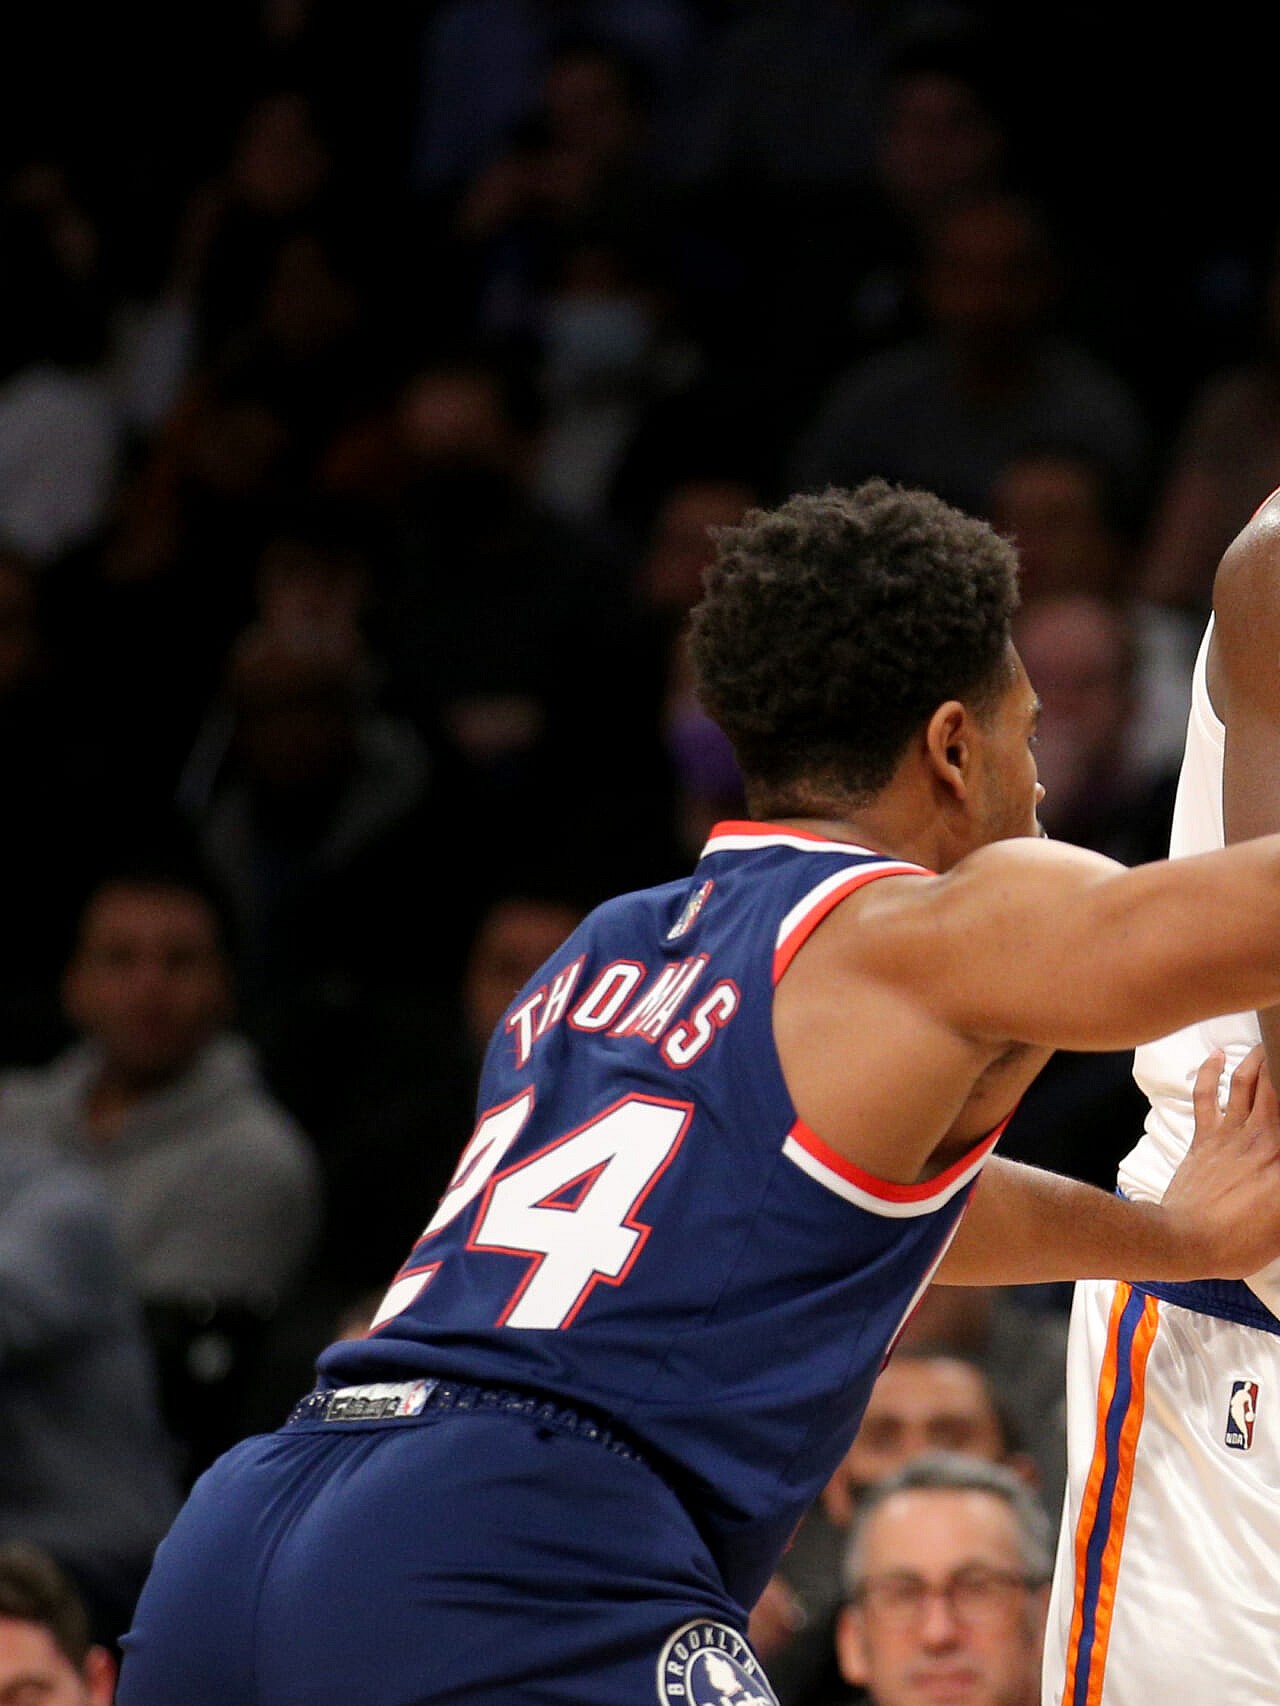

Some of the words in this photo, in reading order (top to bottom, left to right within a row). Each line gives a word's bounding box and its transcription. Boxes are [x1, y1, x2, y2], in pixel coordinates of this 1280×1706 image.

[505, 954, 741, 1070] THOMAS
[363, 1084, 695, 1338] 24
[667, 1626, 757, 1697] BROOKLYN
